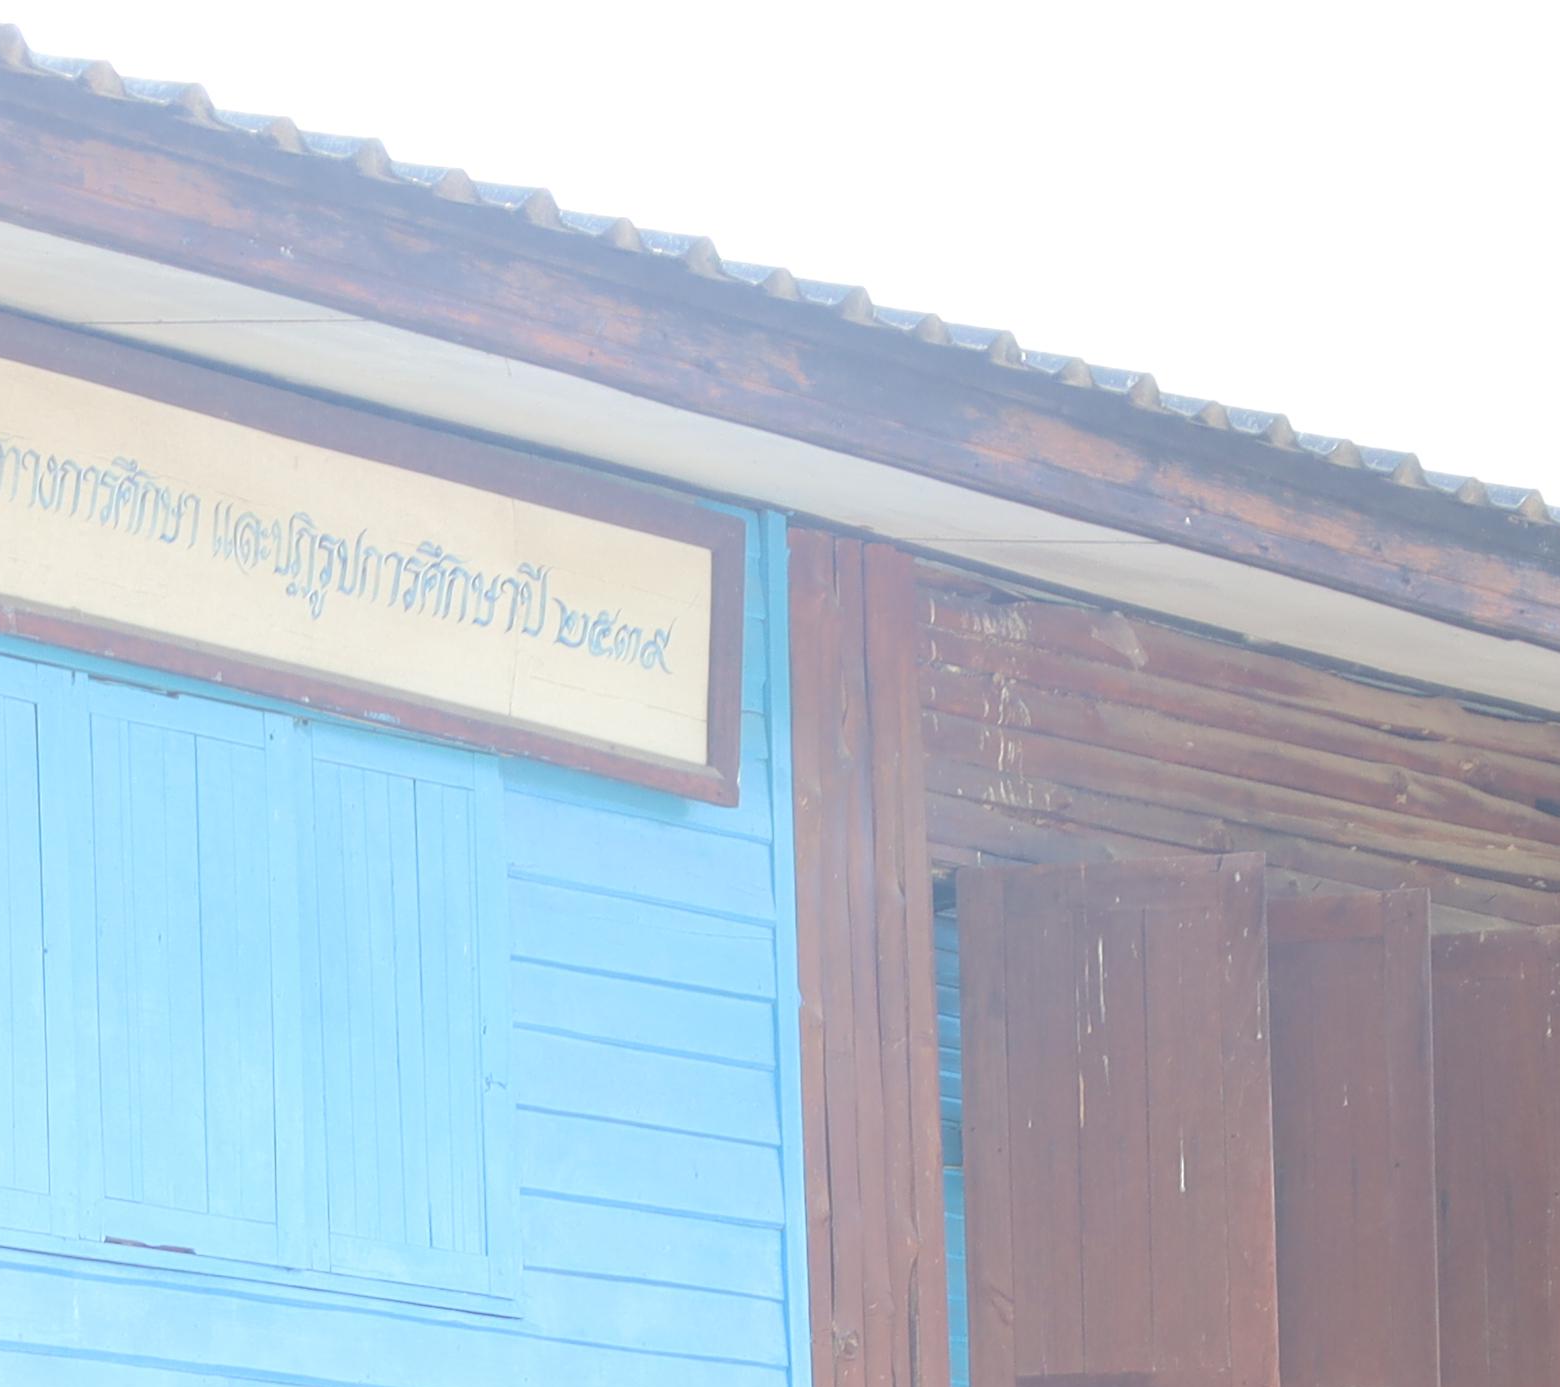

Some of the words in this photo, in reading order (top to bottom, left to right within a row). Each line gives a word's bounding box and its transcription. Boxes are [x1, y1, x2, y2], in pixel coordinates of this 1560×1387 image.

[212, 501, 554, 640] และปฏิรูปการศึกษาปี
